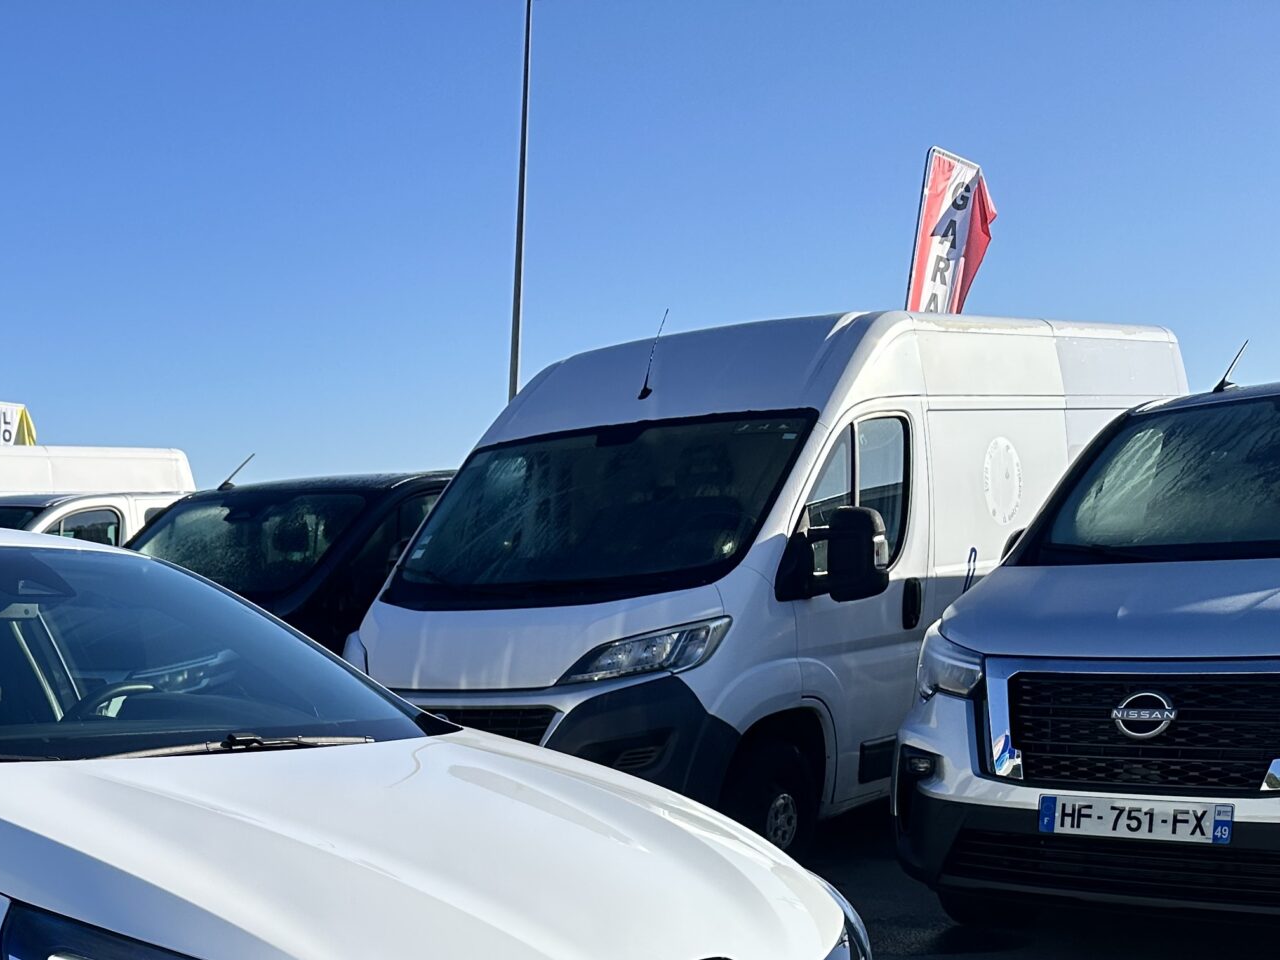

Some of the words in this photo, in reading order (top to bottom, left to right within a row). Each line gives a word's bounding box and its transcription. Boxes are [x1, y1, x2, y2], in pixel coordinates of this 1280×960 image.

[1112, 709, 1175, 719] NISSAN
[1043, 817, 1050, 825] F
[1060, 803, 1208, 837] HF-751-FX
[1214, 826, 1230, 839] 49
